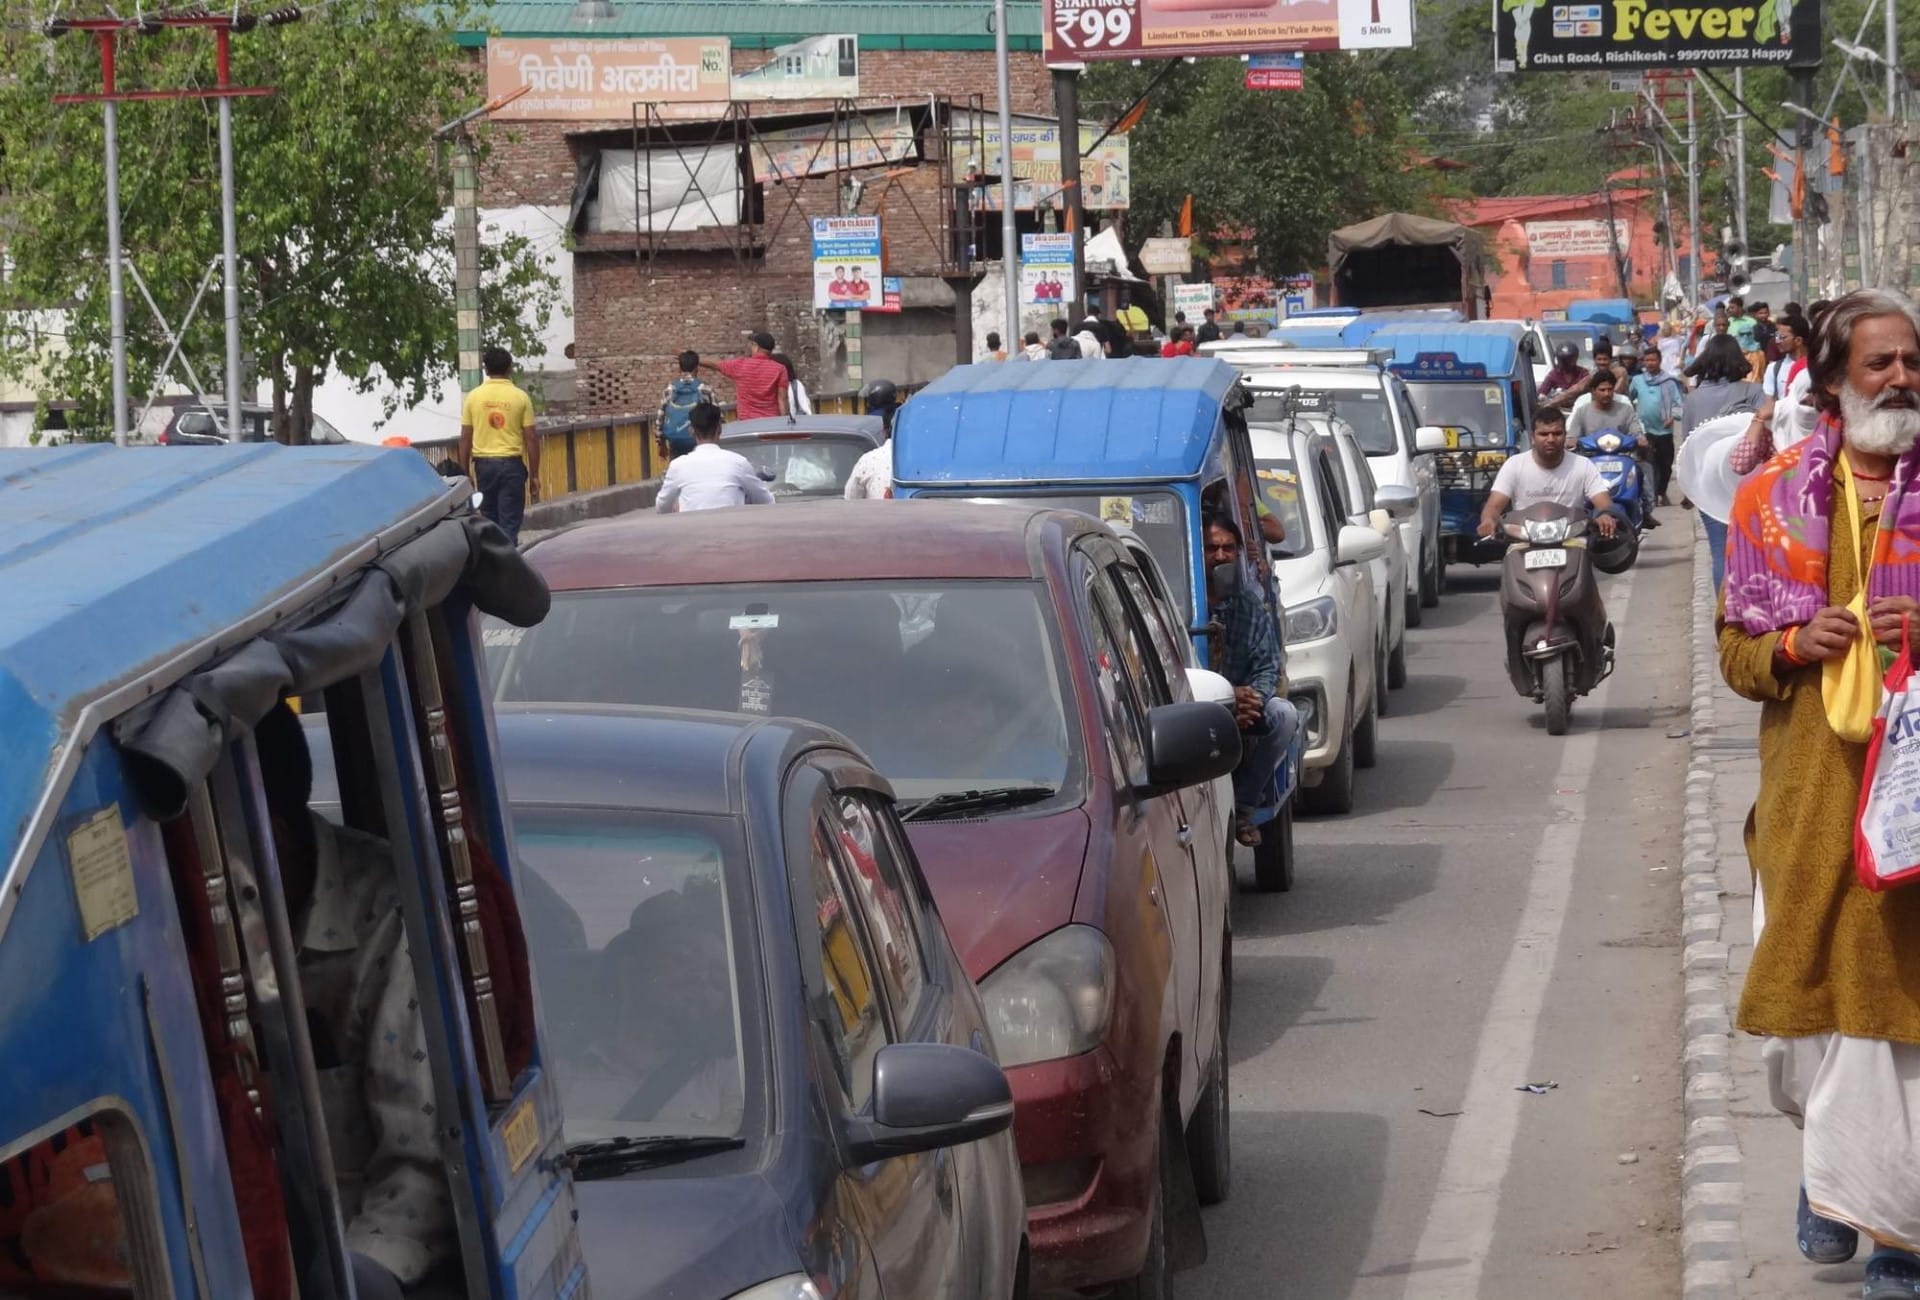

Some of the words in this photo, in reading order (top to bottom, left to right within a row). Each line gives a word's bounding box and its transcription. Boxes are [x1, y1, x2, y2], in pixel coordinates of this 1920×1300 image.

[1147, 31, 1178, 40] Limited
[1227, 28, 1247, 36] Valid
[1612, 0, 1755, 41] Fever
[1534, 53, 1564, 63] Ghat
[1567, 52, 1602, 63] Road,
[1606, 51, 1666, 62] Rishikesh
[1677, 49, 1749, 60] 9997017232
[1752, 48, 1792, 60] Happy
[519, 54, 593, 92] त्रिवेणी
[601, 52, 698, 93] अलमीरा
